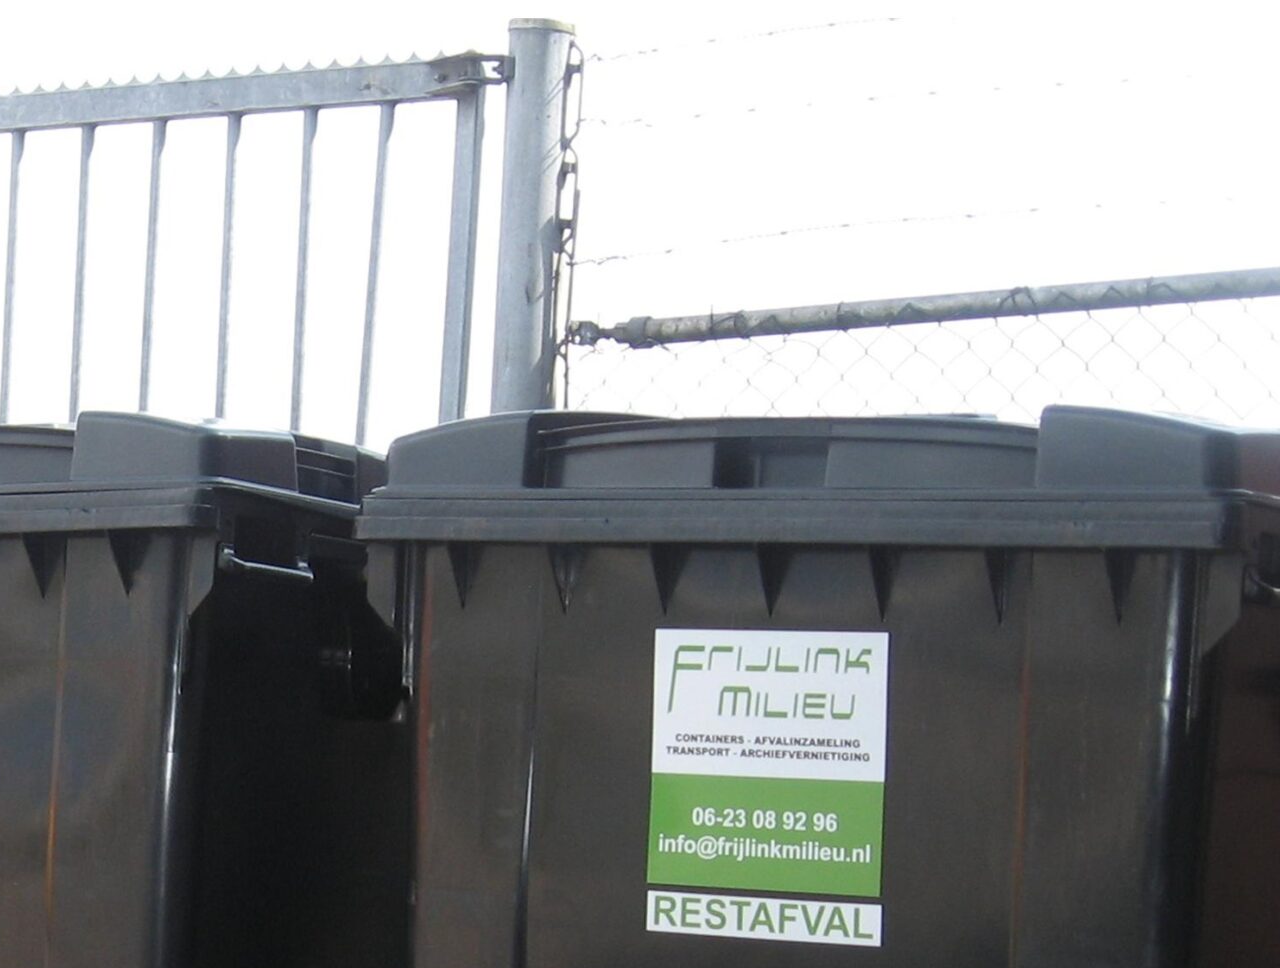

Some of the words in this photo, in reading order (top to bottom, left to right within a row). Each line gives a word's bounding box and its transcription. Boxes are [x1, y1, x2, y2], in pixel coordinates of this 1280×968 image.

[675, 733, 744, 745] CONTAINERS
[754, 736, 861, 748] AFVALINZAMELING
[666, 746, 730, 757] TRANSPORT
[740, 748, 870, 762] ARCHIEFVERNIETIGING
[692, 807, 746, 828] 06-23
[752, 809, 776, 829] 08
[782, 811, 807, 831] 92
[813, 813, 838, 832] 96
[658, 834, 871, 863] info@frijlinkmilieu.nl
[653, 896, 873, 939] RESTAFVAL
